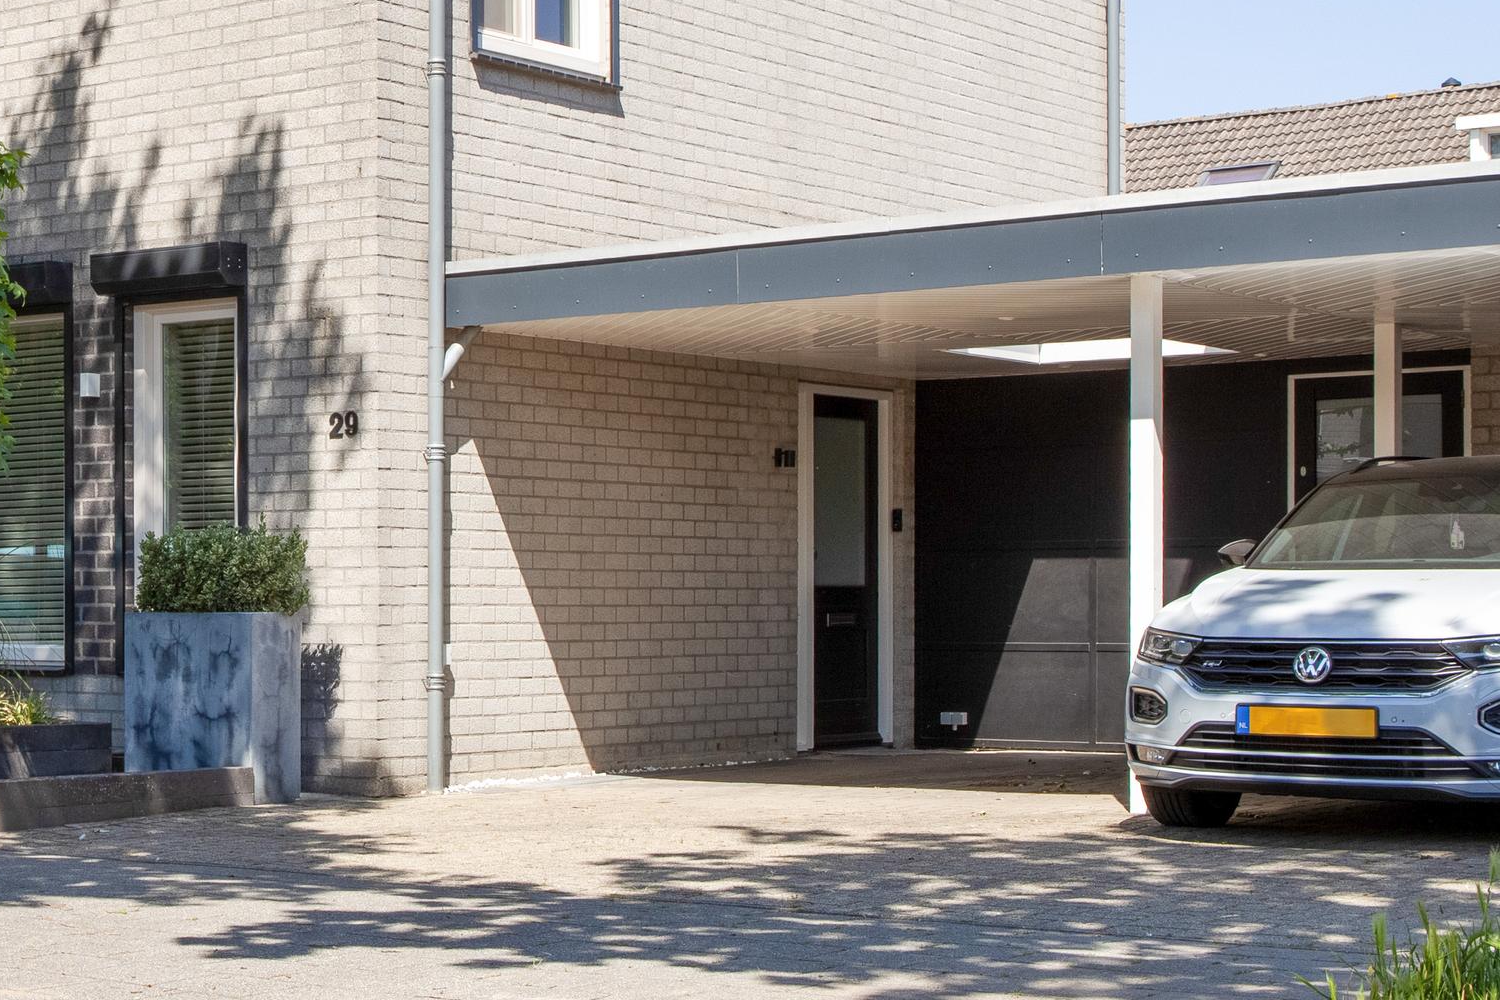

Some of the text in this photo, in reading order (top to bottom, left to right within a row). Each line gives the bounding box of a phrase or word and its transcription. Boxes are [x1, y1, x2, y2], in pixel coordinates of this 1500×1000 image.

[329, 411, 359, 439] 29
[1297, 648, 1329, 680] VW
[1238, 721, 1248, 729] NL
